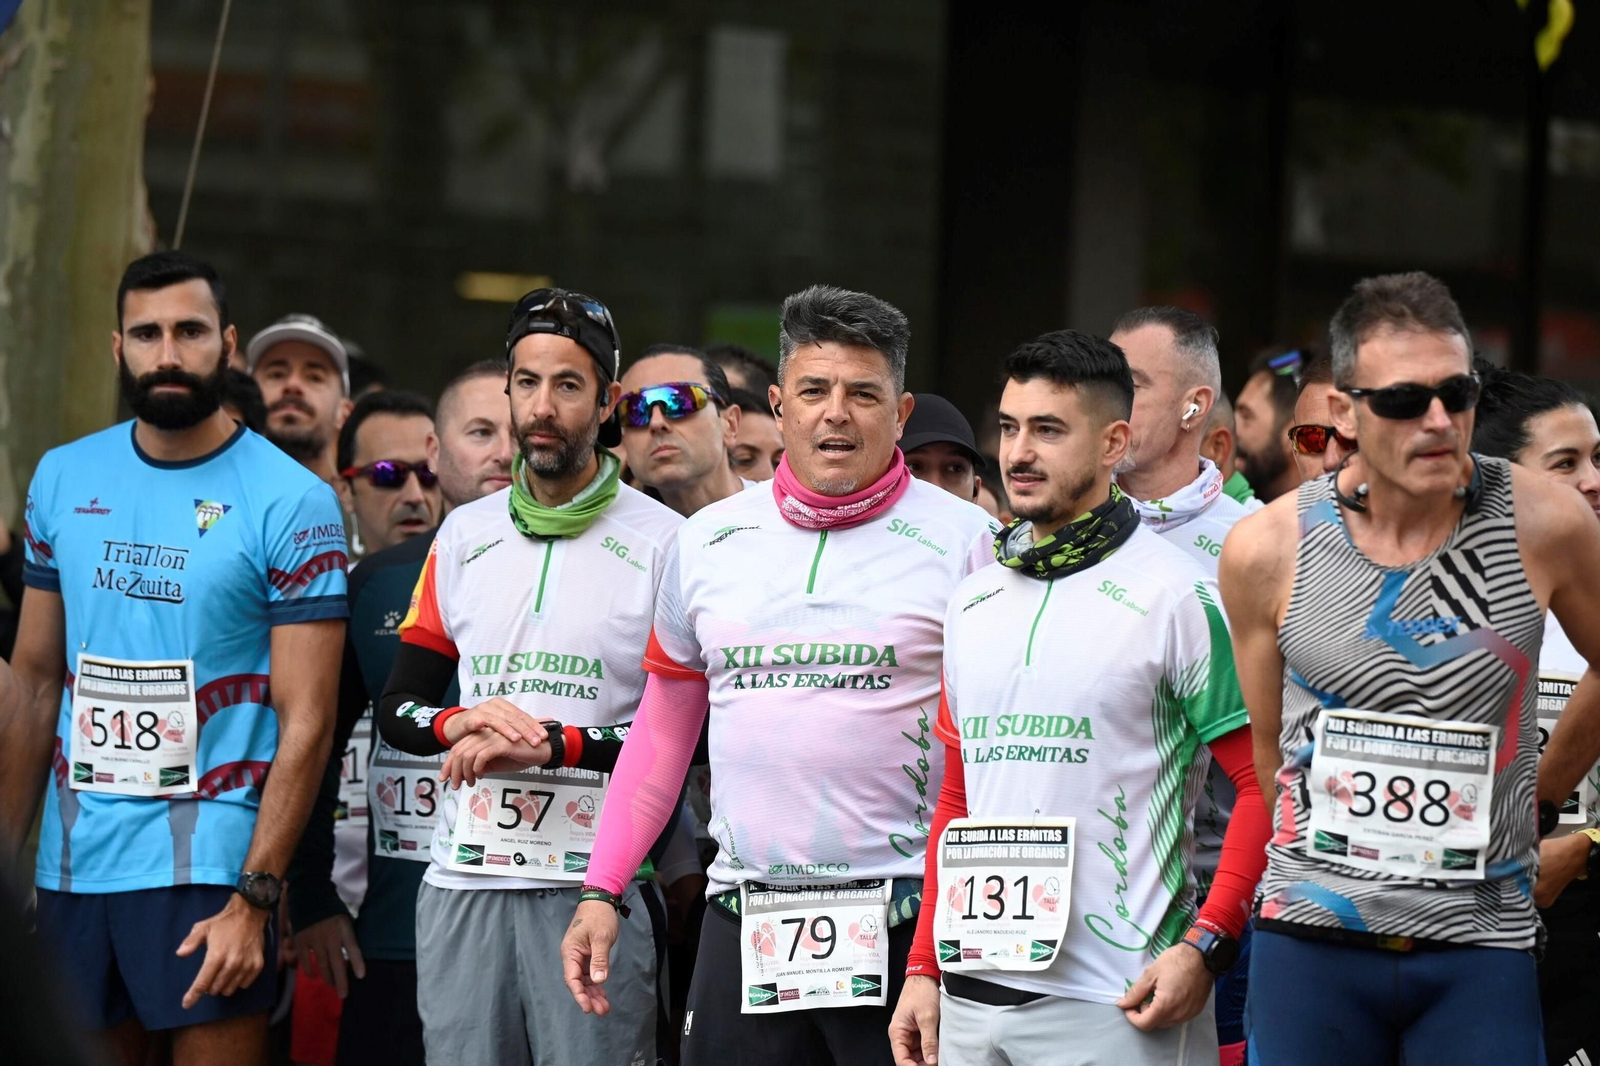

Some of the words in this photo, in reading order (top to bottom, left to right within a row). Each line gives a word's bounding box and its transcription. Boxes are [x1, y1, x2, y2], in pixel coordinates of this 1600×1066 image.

[312, 524, 347, 540] IMDEC
[886, 518, 922, 538] SIG
[917, 536, 948, 557] Laboral
[601, 536, 630, 559] SIG
[1194, 535, 1223, 557] SIG
[1097, 580, 1128, 602] SIG
[1122, 599, 1150, 617] Laboral
[470, 654, 504, 676] XII
[507, 652, 604, 680] SUBIDA
[720, 645, 766, 670] XII
[772, 643, 900, 668] SUBIDA
[112, 668, 118, 679] A
[119, 668, 134, 680] LAS
[135, 668, 182, 680] ERMITAS
[734, 674, 746, 690] A
[749, 673, 791, 689] LAS
[792, 672, 892, 690] ERMITAS
[130, 684, 141, 696] DE
[142, 684, 186, 696] ORGANOS
[472, 683, 482, 697] A
[487, 681, 518, 696] LAS
[521, 679, 599, 700] ERMITAS
[1538, 682, 1578, 695] RMITA
[91, 707, 161, 751] 518
[996, 714, 1096, 740] SUBIDA
[1328, 718, 1345, 734] XII
[1346, 721, 1394, 739] SUBIDA
[1395, 727, 1404, 740] A
[1406, 728, 1430, 743] LAS
[1432, 731, 1483, 748] ERMITAS
[975, 746, 1005, 763] LAS
[1005, 745, 1089, 764] ERMITAS
[1350, 739, 1363, 752] LA
[1421, 749, 1436, 760] DE
[1437, 750, 1486, 766] ORGANOS
[556, 766, 600, 780] ORGANOS
[394, 775, 448, 818] 13
[1349, 771, 1450, 827] 388
[497, 788, 556, 832] 57
[947, 831, 960, 843] XII
[960, 830, 989, 842] SUBIDA
[990, 830, 996, 842] A
[998, 829, 1016, 842] LAS
[1017, 830, 1062, 842] ERMITAS
[946, 848, 963, 860] POR
[1009, 847, 1020, 858] DE
[1022, 847, 1066, 859] ORGANOS
[786, 863, 850, 875] IMDECO
[1084, 785, 1151, 952] Córdoba
[749, 894, 764, 907] POR
[765, 893, 774, 905] LA
[823, 891, 835, 900] DE
[837, 890, 883, 900] ORGANOS
[962, 875, 1034, 920] 131
[781, 916, 837, 963] 79
